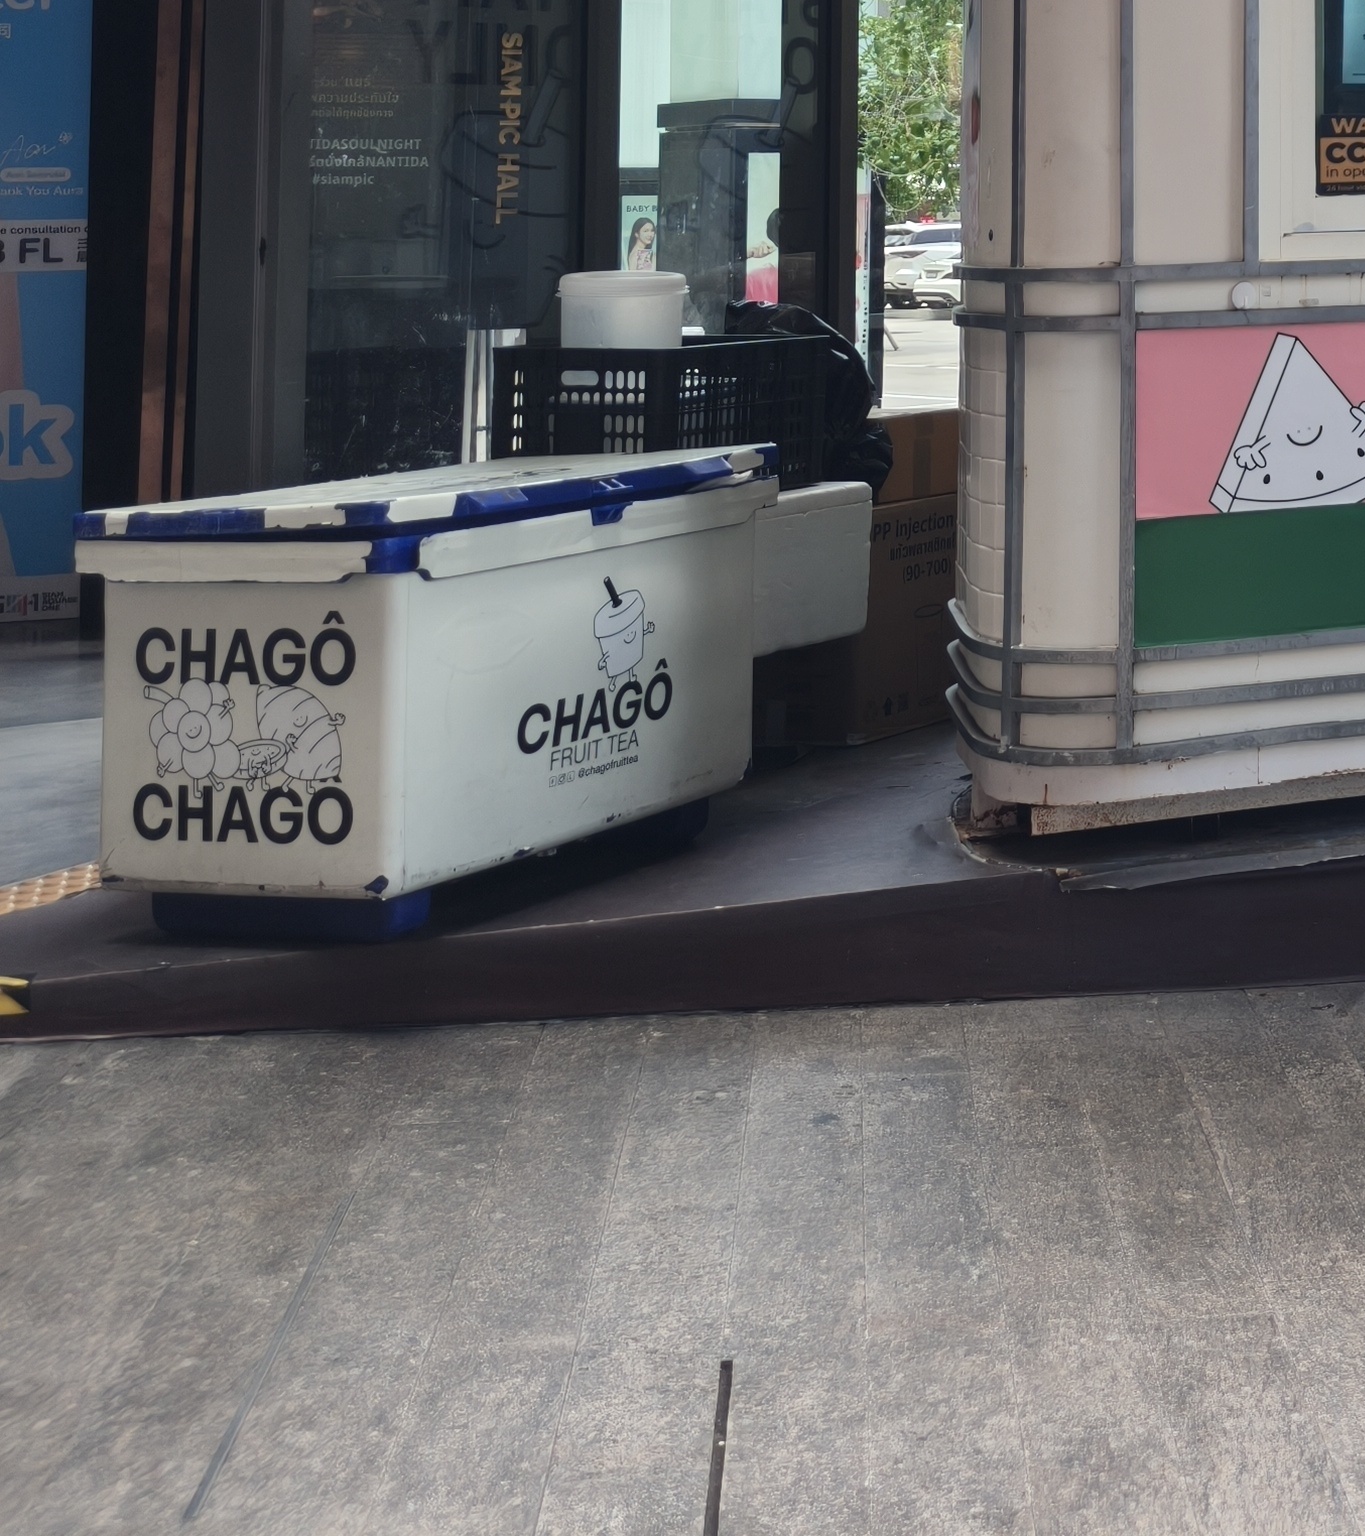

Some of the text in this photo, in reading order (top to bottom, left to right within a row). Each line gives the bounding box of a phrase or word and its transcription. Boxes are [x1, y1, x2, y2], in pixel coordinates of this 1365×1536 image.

[1326, 166, 1339, 178] in
[496, 153, 520, 225] HALL
[626, 205, 650, 213] BABY
[11, 225, 81, 235] consultation
[19, 237, 63, 264] FL
[873, 513, 954, 542] PP Injection
[902, 556, 952, 584] (90-700)
[135, 611, 358, 687] CHAGÔ
[516, 658, 673, 755] CHAGÔ
[550, 729, 639, 771] FRUIT TEA
[578, 754, 639, 779] @chagofruittea
